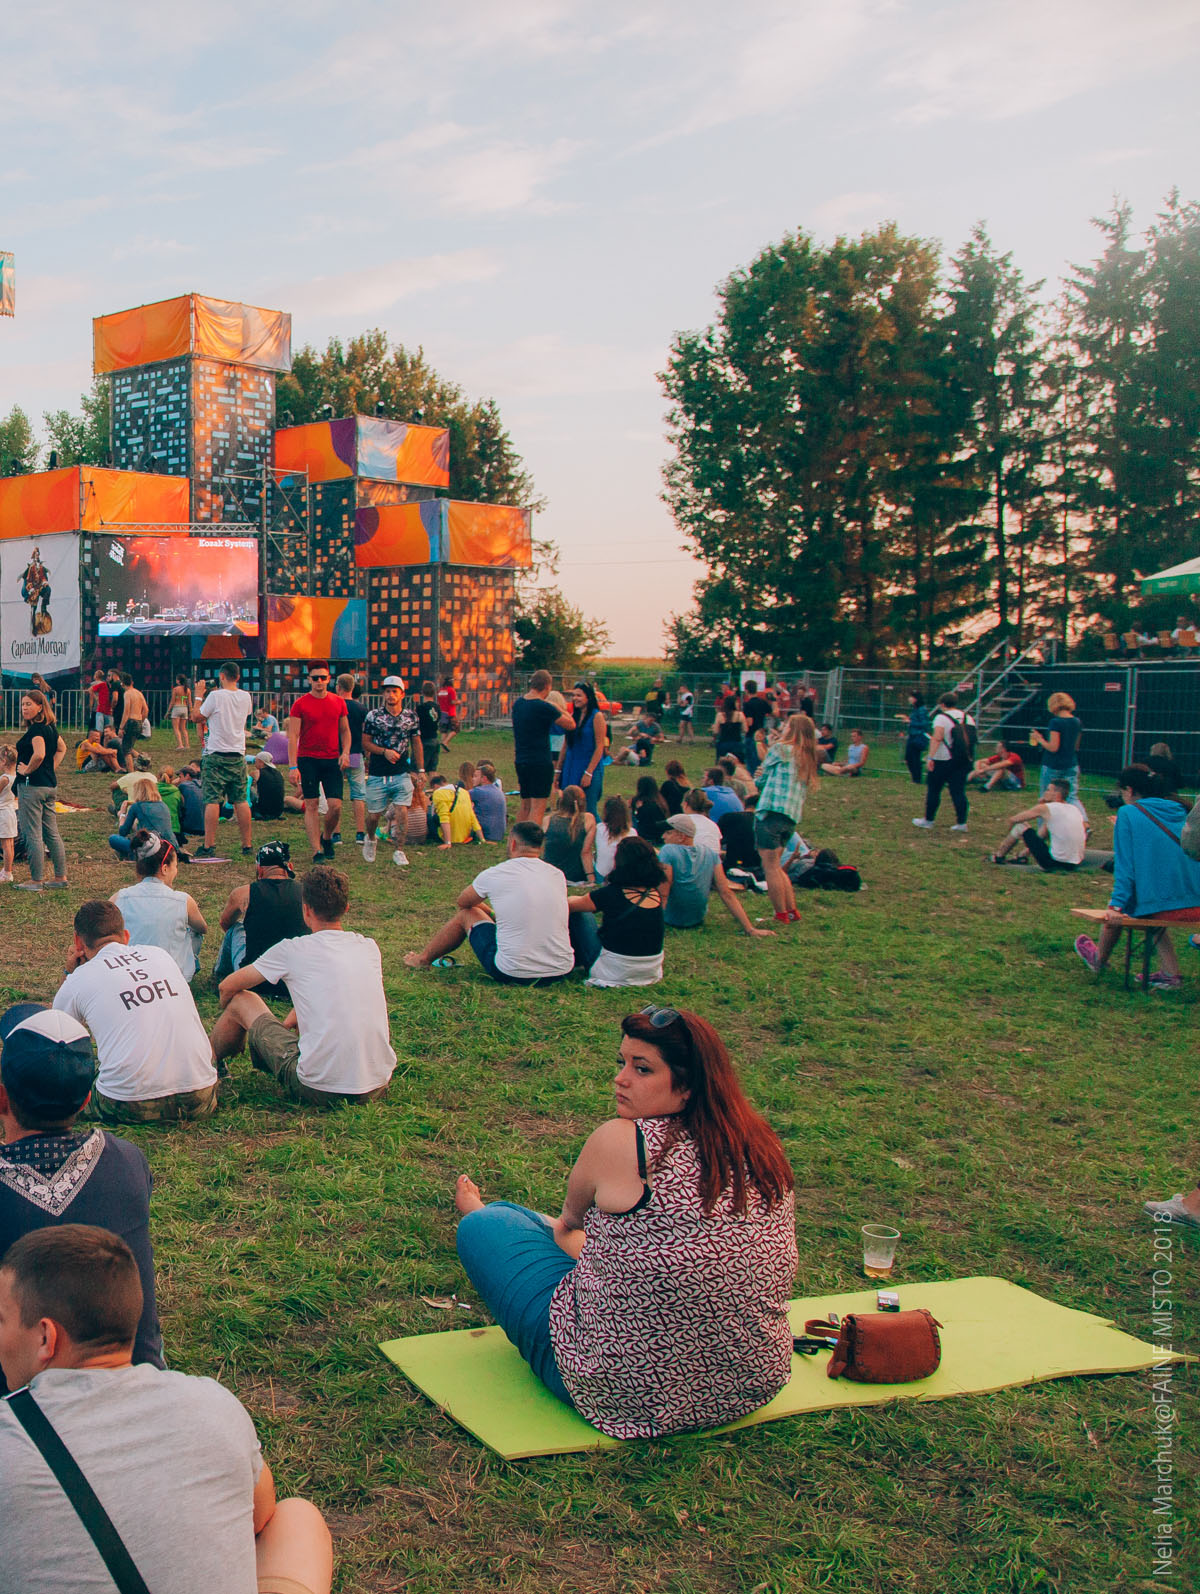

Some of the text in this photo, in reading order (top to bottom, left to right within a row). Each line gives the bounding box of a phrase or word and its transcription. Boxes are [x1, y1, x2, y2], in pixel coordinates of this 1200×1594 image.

[11, 638, 37, 659] Captain
[103, 951, 148, 970] LIFE
[126, 968, 149, 982] is
[119, 979, 179, 1011] ROFL
